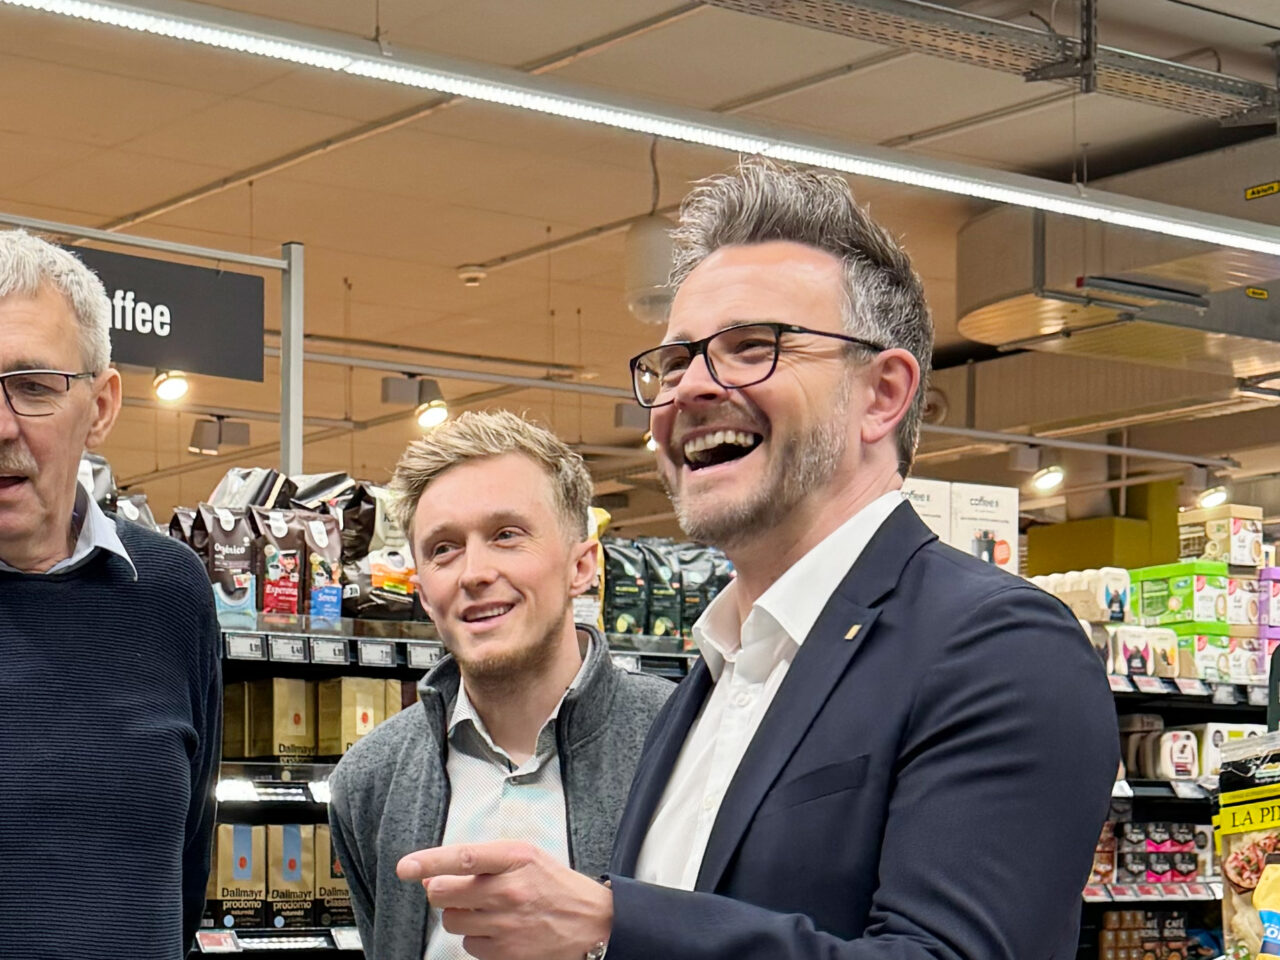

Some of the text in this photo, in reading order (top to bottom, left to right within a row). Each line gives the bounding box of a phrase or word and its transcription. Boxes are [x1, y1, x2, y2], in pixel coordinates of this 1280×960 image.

[1232, 810, 1253, 828] LA
[221, 887, 263, 898] Dallmayr
[271, 889, 312, 900] Dallmayr
[223, 899, 262, 910] prodomo
[273, 901, 311, 911] prodomo
